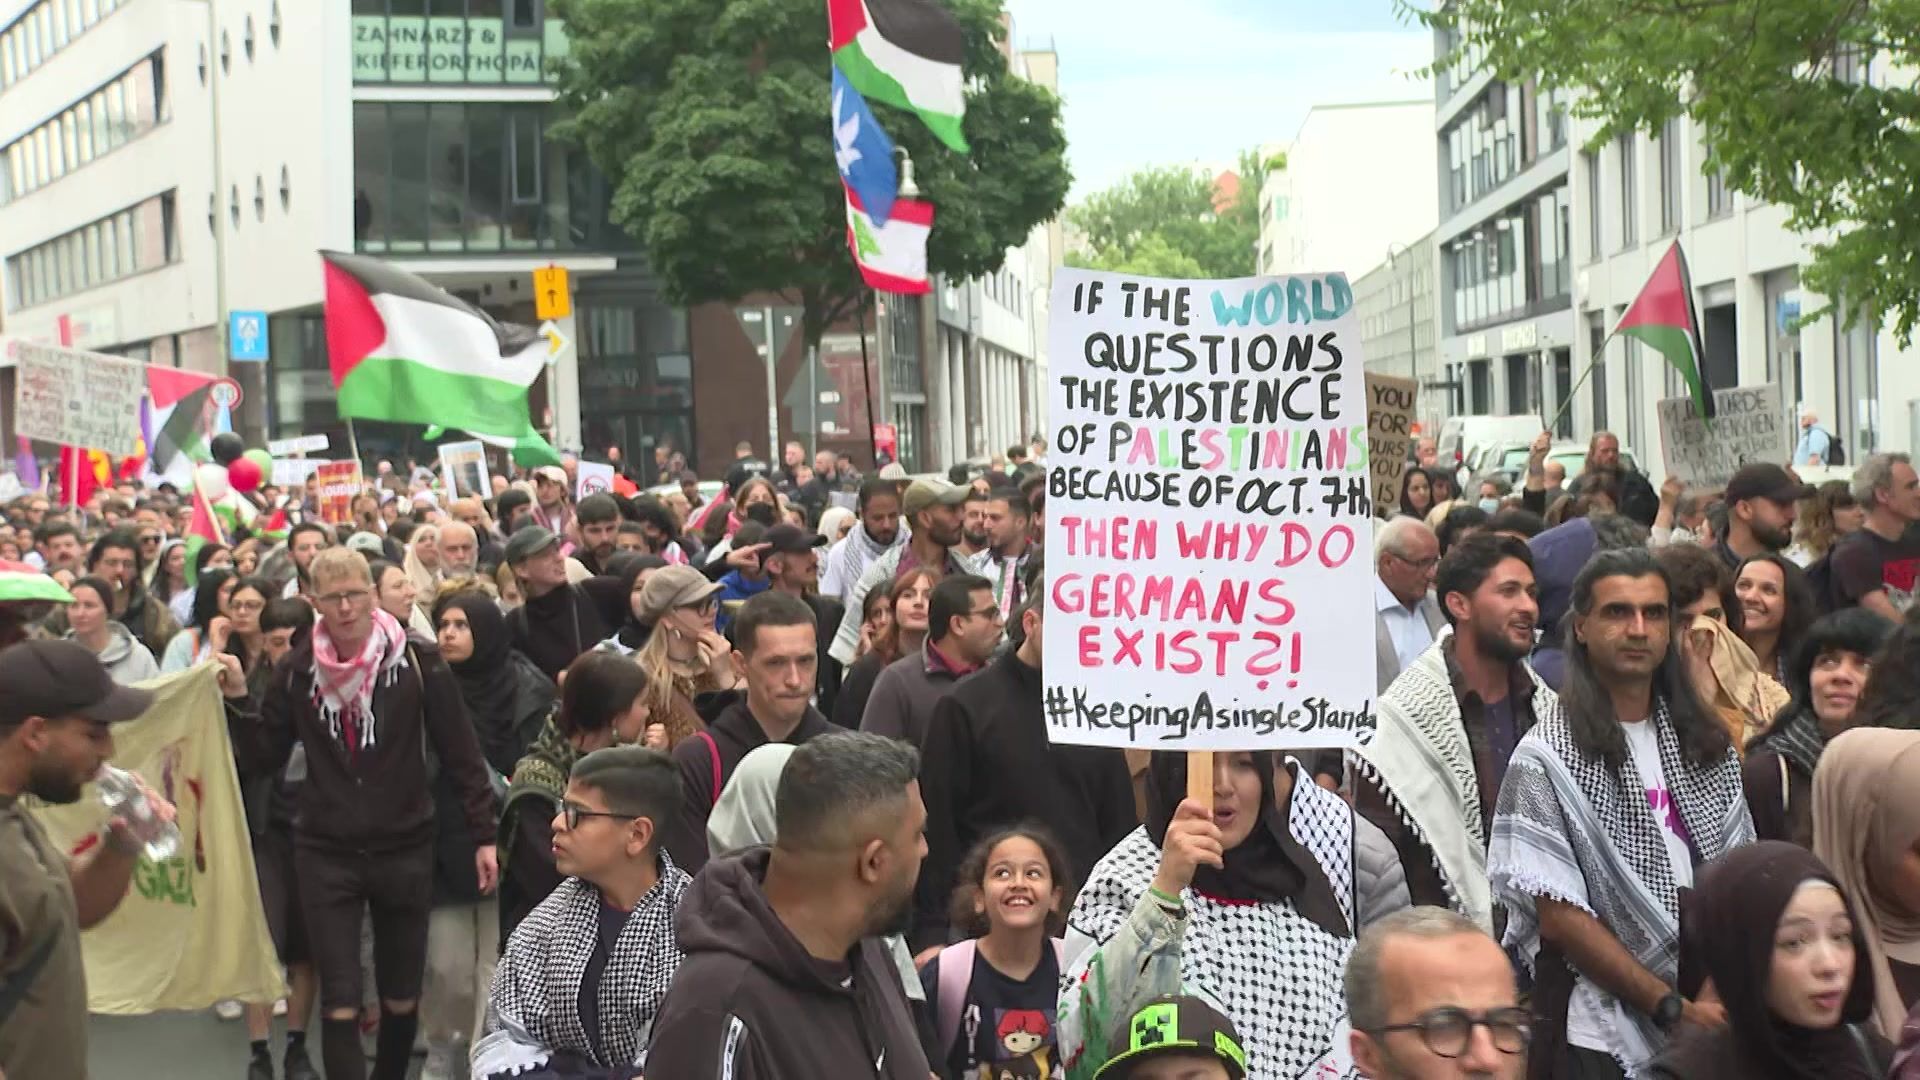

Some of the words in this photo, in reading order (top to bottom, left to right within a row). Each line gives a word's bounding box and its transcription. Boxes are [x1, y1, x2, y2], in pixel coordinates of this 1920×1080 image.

[356, 27, 473, 43] ZAHNARZT
[480, 28, 496, 44] &
[1074, 280, 1103, 315] IF
[1121, 282, 1191, 326] THE
[1210, 271, 1353, 327] WORLD
[1084, 331, 1342, 376] QUESTIONS
[1060, 376, 1118, 416] THE
[1129, 373, 1342, 424] EXISTENCE
[1373, 384, 1412, 409] YOU
[1057, 423, 1097, 455] OF
[1108, 421, 1369, 471] PALESTINIANS
[1368, 410, 1408, 435] FOR
[1050, 466, 1181, 507] BECAUSE
[1188, 474, 1233, 508] OF
[1236, 477, 1313, 515] OCT.
[1377, 482, 1394, 503] IS
[1060, 517, 1157, 560] THEN
[1176, 520, 1269, 561] WHY
[1274, 522, 1355, 568] DO
[1052, 573, 1296, 625] GERMANS
[1078, 625, 1302, 690] EXIST?!
